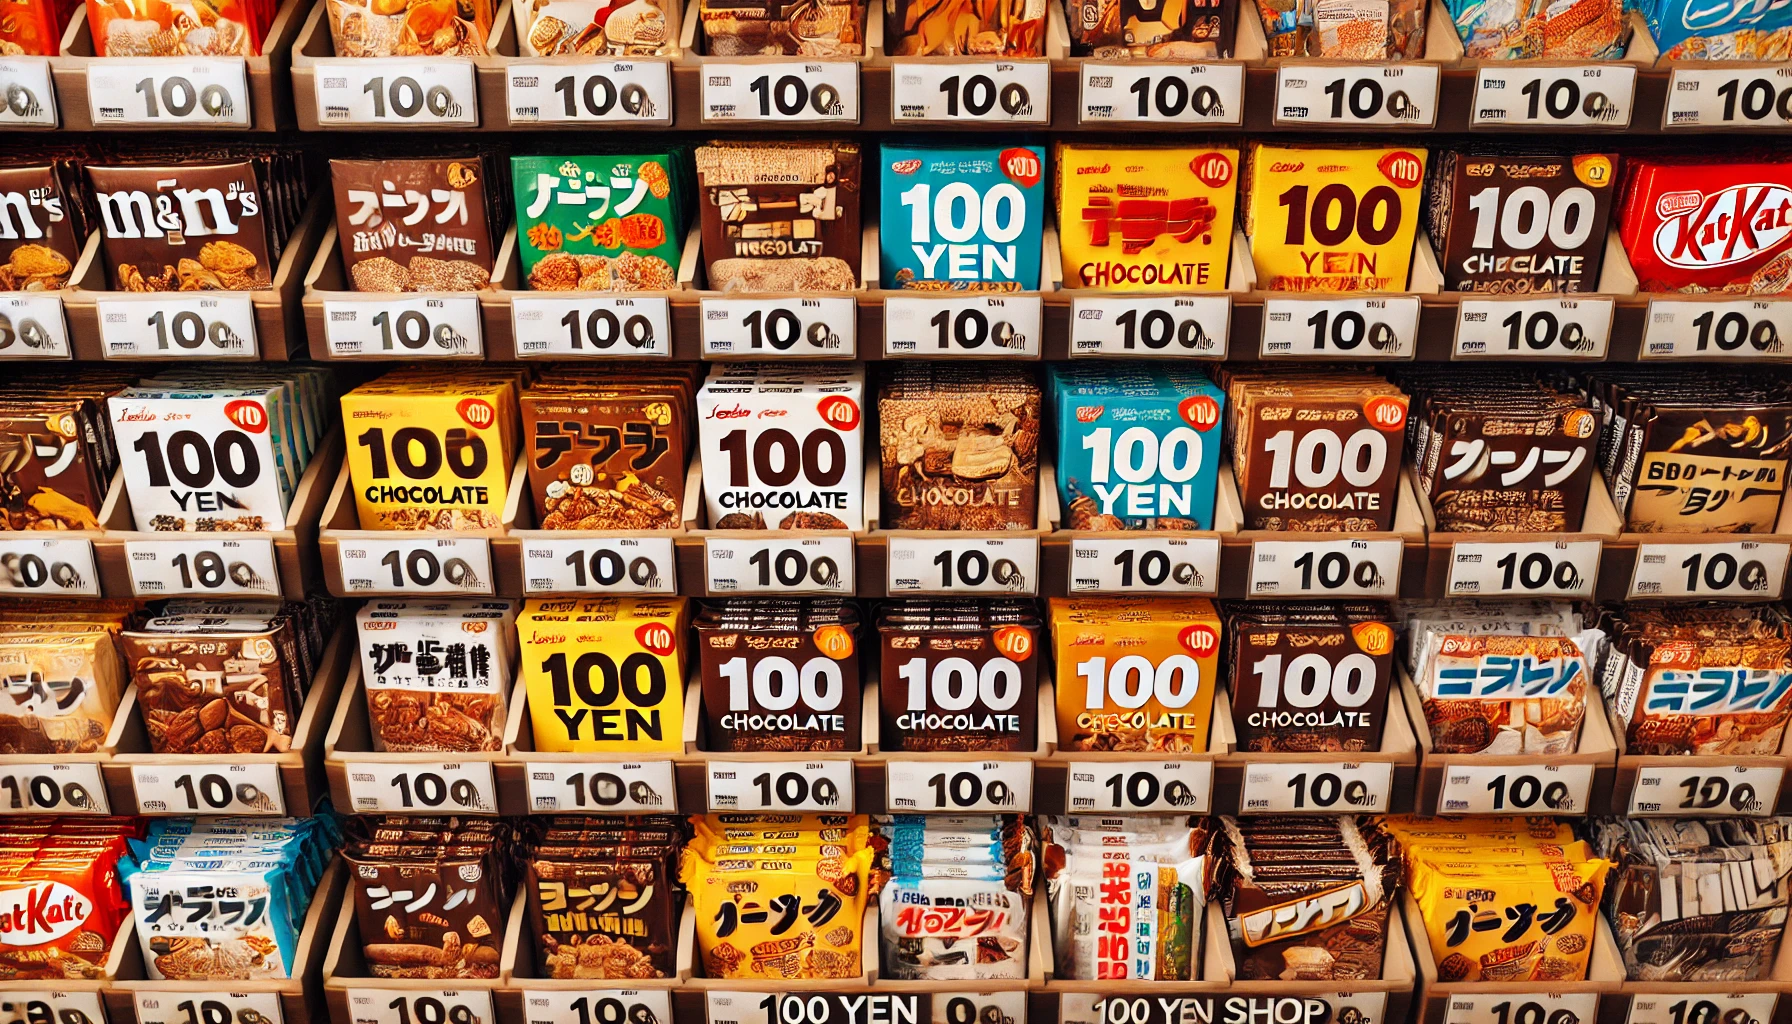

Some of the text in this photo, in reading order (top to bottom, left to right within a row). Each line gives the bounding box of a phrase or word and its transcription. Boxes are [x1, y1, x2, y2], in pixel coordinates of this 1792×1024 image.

[901, 181, 1026, 243] 100
[1279, 183, 1401, 246] 100
[1469, 186, 1595, 250] 100
[912, 244, 1016, 281] YEN
[1079, 262, 1210, 286] CHOCOLATE
[134, 429, 260, 488] 100
[719, 428, 846, 487] 100
[1083, 426, 1203, 483] 100
[1264, 427, 1387, 489] 100
[365, 485, 490, 505] CHOCOLATE
[718, 490, 848, 510] CHOCOLATE
[1093, 484, 1192, 517] YEN
[1259, 491, 1380, 511] CHOCOLATE
[542, 652, 666, 707] 100
[718, 656, 843, 711] 100
[898, 656, 1022, 712] 100
[1077, 654, 1199, 710] 100
[1252, 654, 1376, 708] 100
[554, 708, 662, 741] YEN
[719, 714, 845, 732] CHOCOLATE
[896, 713, 1020, 732] CHOCOLATE
[1247, 711, 1371, 728] CHOCOLATE
[839, 995, 918, 1024] YEN
[1094, 998, 1325, 1024] 100 YEN SHOP
